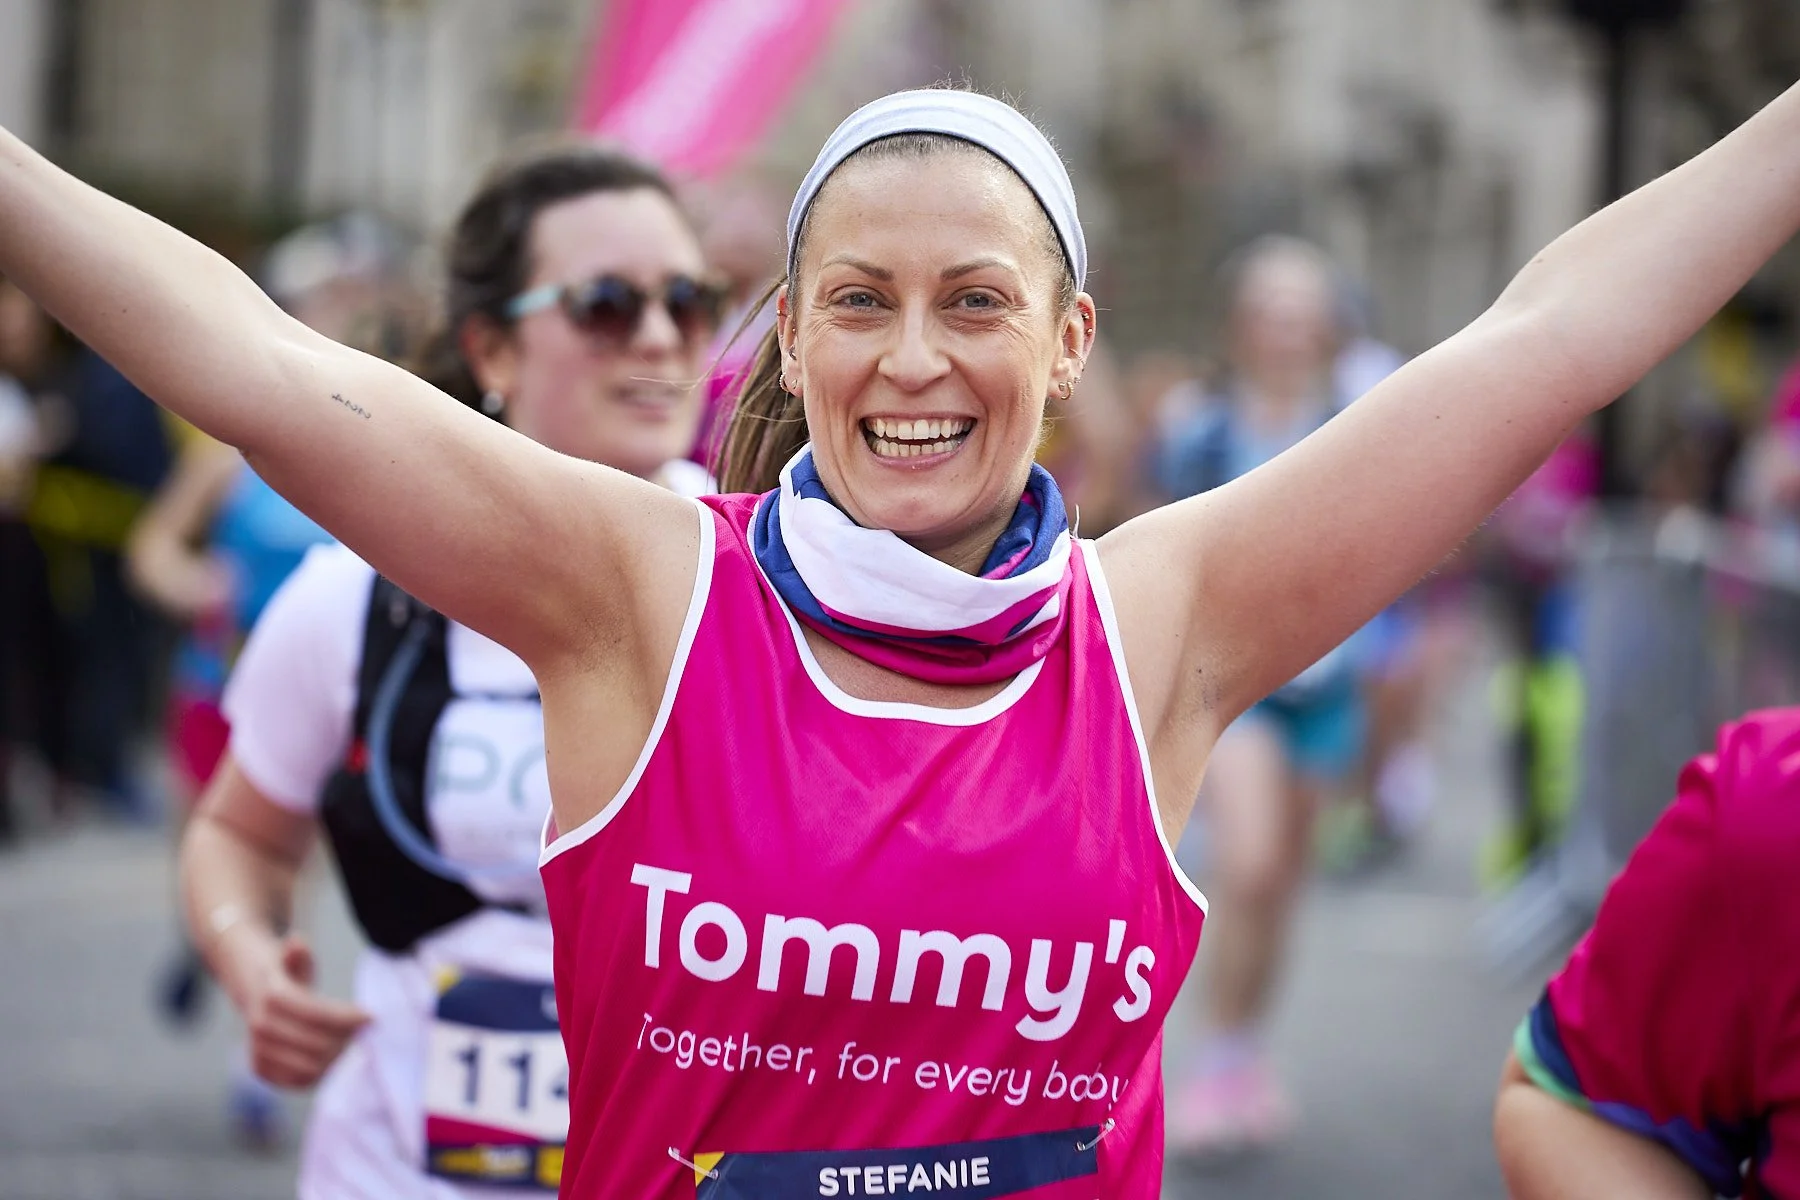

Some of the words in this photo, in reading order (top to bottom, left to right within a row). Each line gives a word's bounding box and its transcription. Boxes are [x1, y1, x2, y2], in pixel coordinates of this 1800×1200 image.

[630, 862, 1156, 1041] Tommy's
[637, 1012, 816, 1085] Together,
[838, 1041, 901, 1084] for
[914, 1060, 1032, 1106] every
[818, 1156, 991, 1197] STEFANIE
